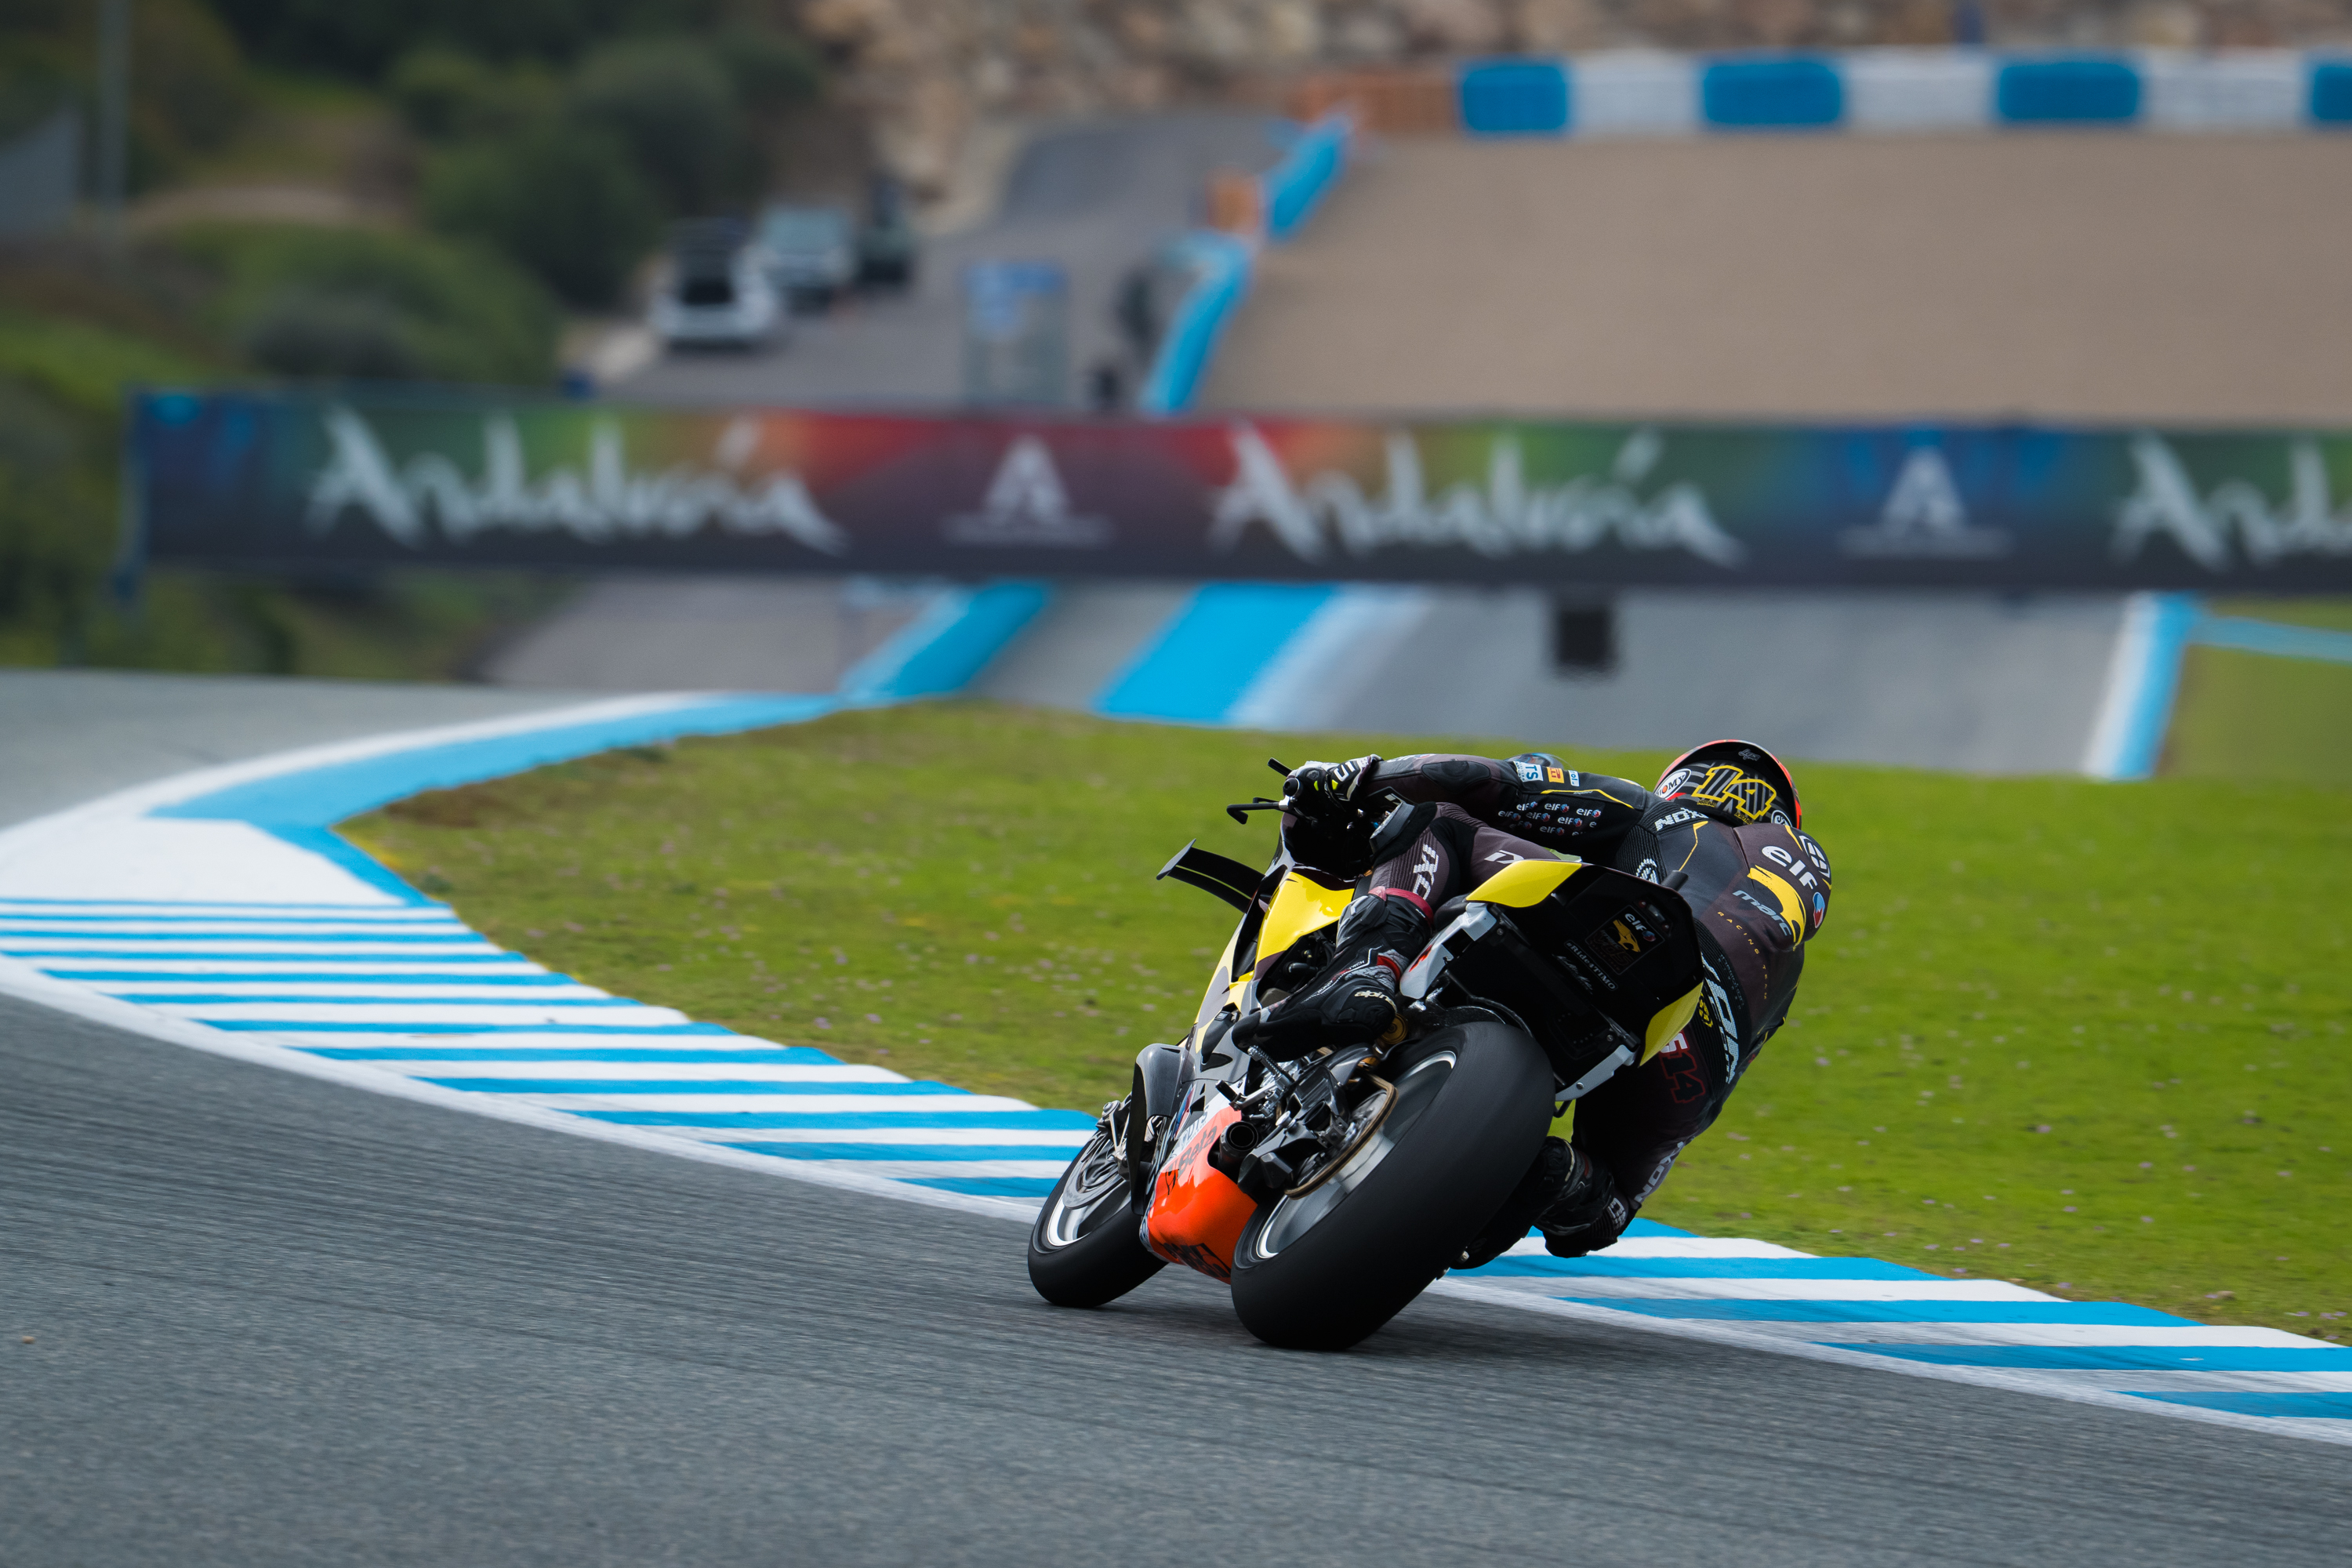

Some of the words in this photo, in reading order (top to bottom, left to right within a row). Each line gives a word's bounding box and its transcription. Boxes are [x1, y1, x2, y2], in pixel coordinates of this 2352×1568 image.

[1656, 775, 1686, 797] UOMY
[1691, 764, 1777, 820] 14
[1516, 802, 1529, 811] elf
[1544, 803, 1560, 811] elf
[1576, 808, 1592, 817] elf
[1526, 811, 1541, 820] elf
[1557, 816, 1573, 825] elf
[1539, 826, 1556, 834] elf
[1762, 846, 1818, 890] elf
[1624, 913, 1647, 932] elf
[1717, 911, 1760, 955] RACING
[1732, 890, 1792, 936] marc
[1566, 942, 1616, 989] #Ride4TIMO
[1178, 1124, 1218, 1178] Beta
